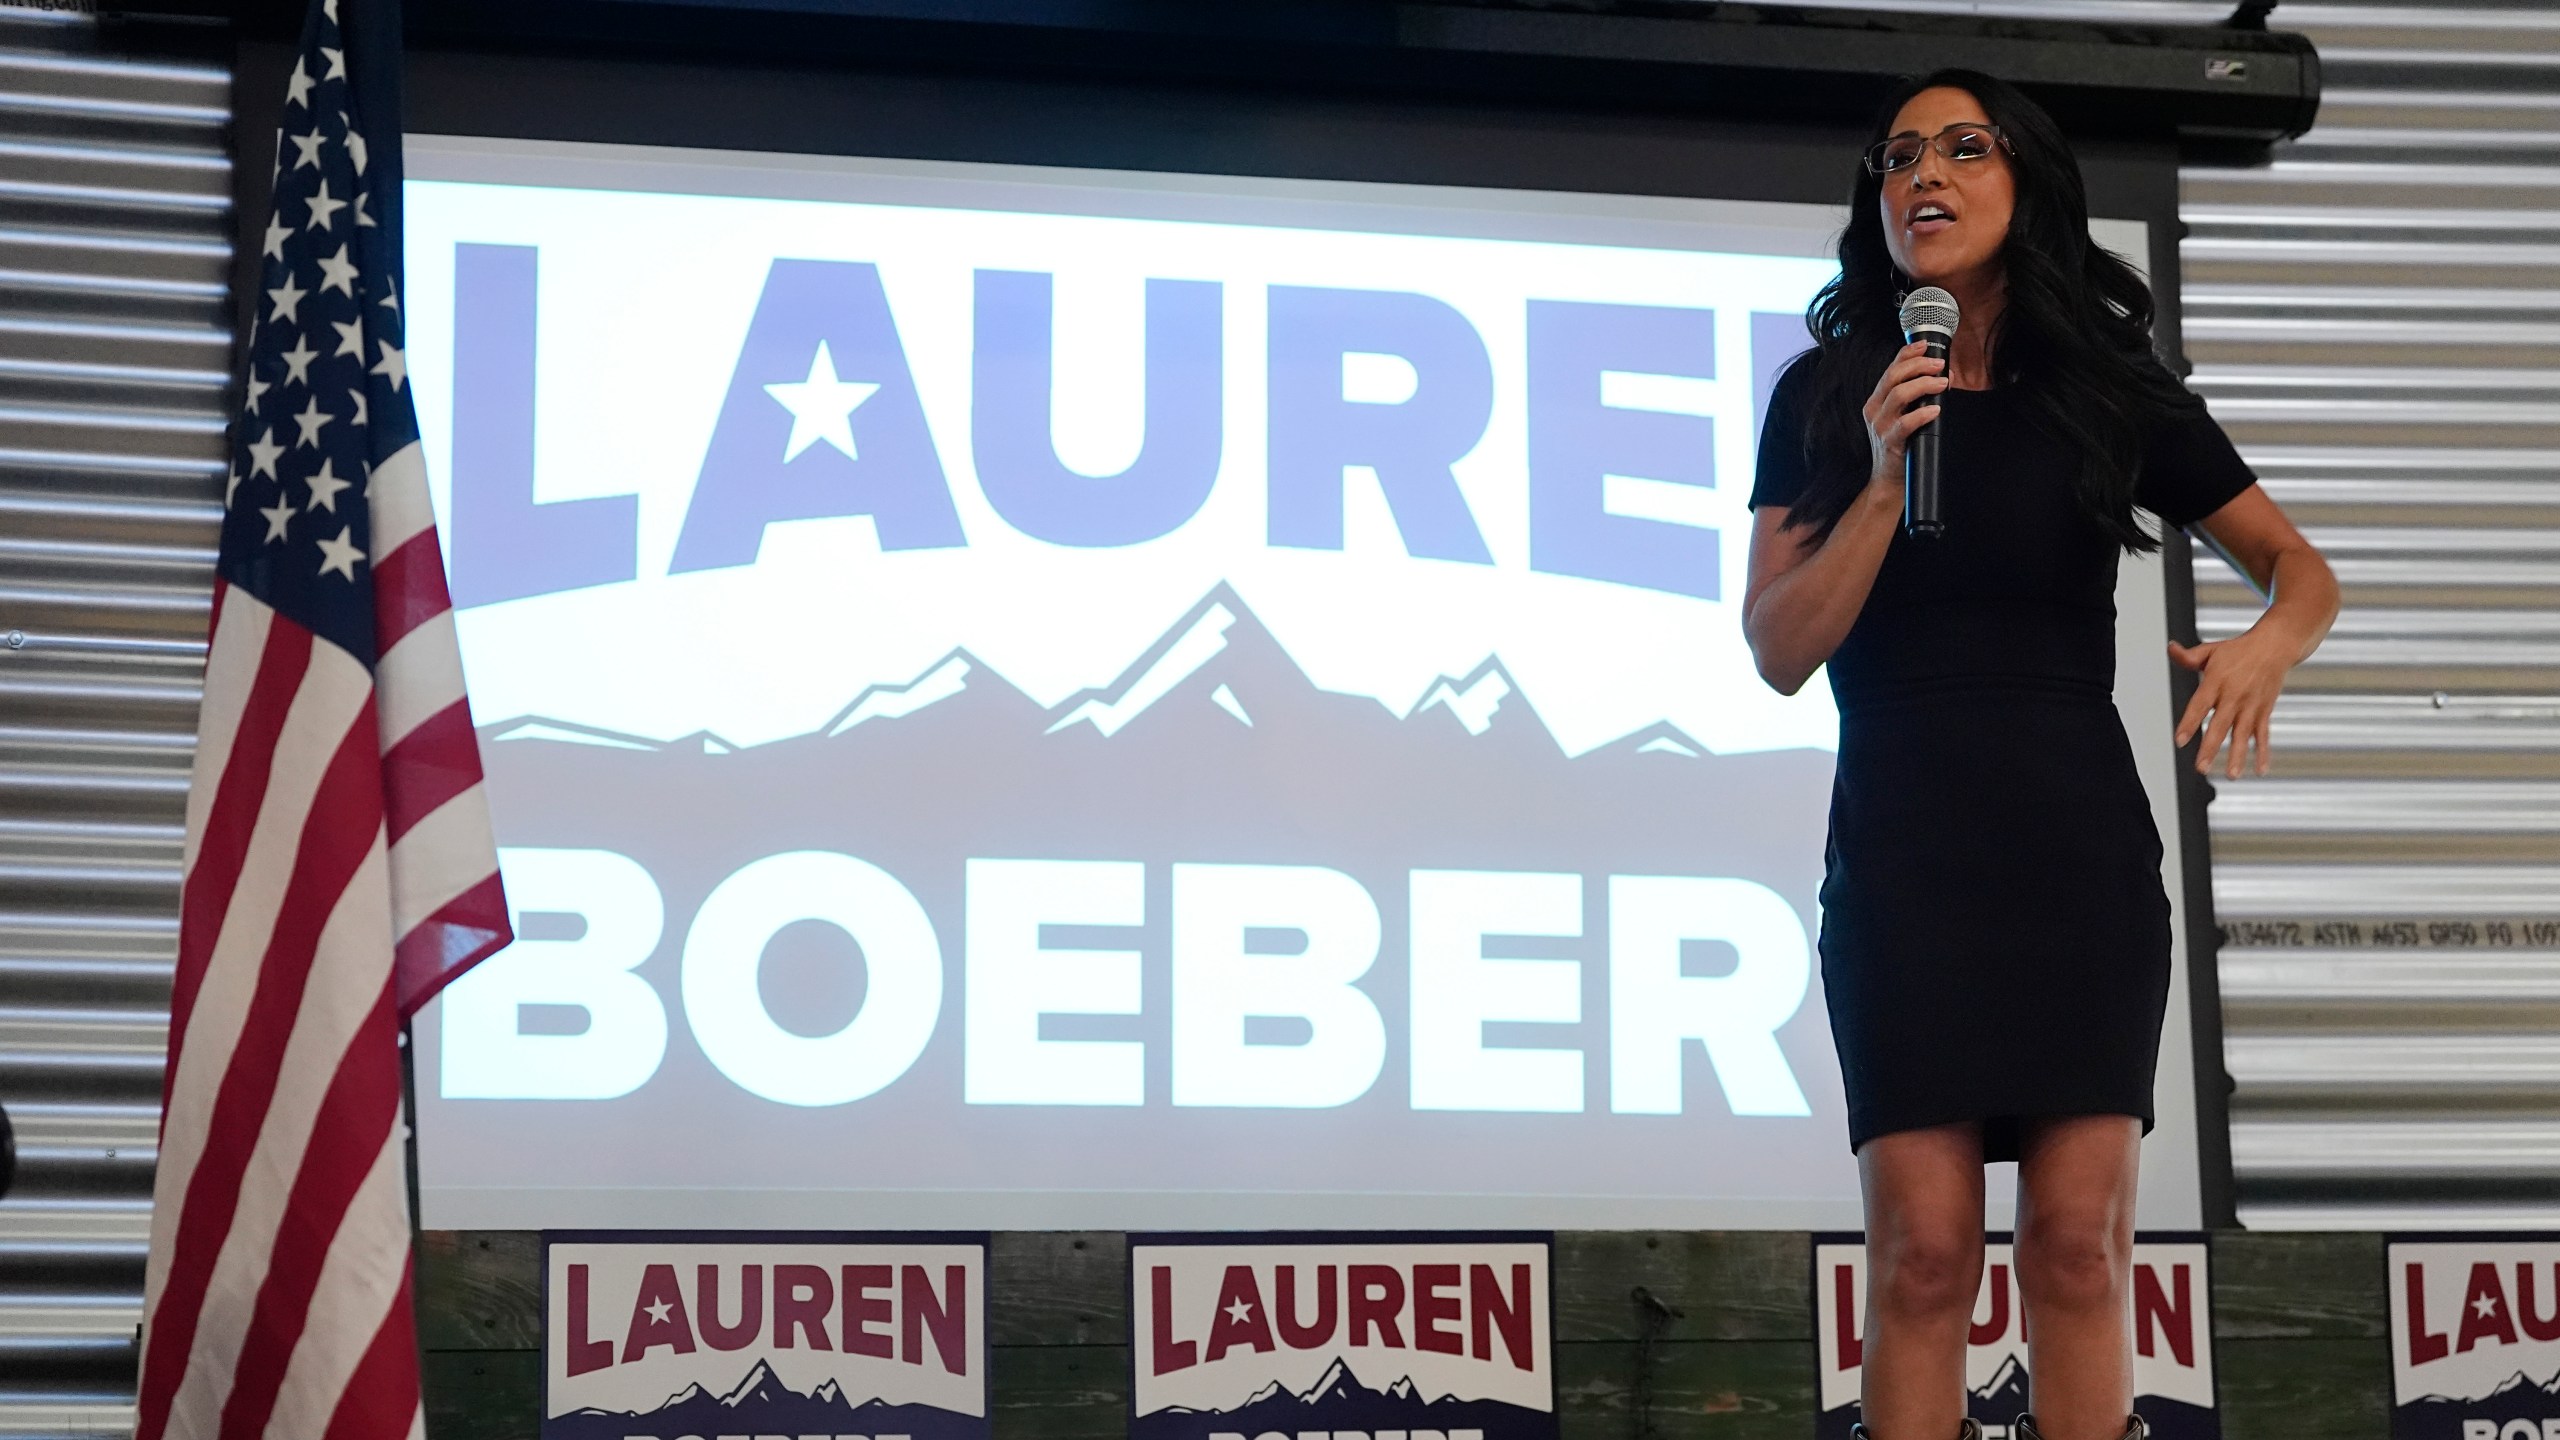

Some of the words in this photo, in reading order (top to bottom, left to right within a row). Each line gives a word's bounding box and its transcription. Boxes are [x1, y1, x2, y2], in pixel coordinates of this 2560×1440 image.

[440, 846, 1824, 1119] BOEBER
[566, 1263, 967, 1377] LAUREN
[1151, 1263, 1534, 1376] LAUREN
